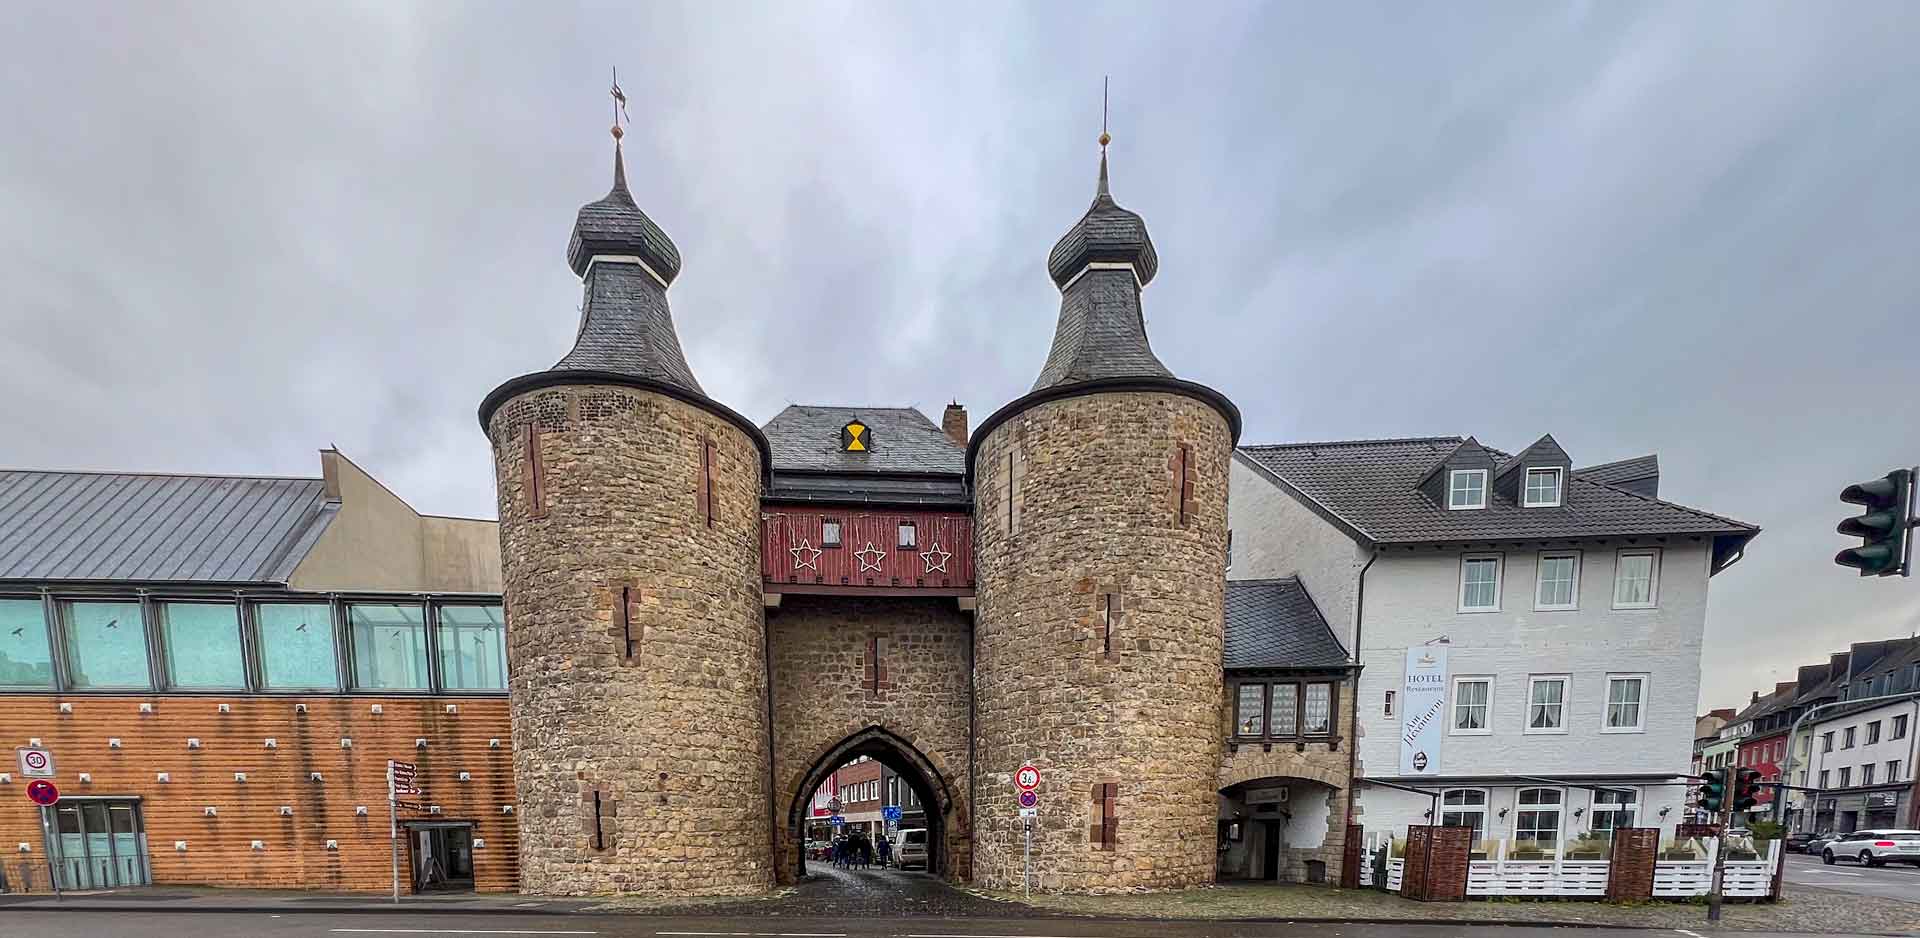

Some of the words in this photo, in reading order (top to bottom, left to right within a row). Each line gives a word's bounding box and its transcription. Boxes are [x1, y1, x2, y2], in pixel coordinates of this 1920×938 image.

[1404, 699, 1444, 747] Hexenturm
[1407, 715, 1420, 732] Am
[29, 756, 42, 764] 30
